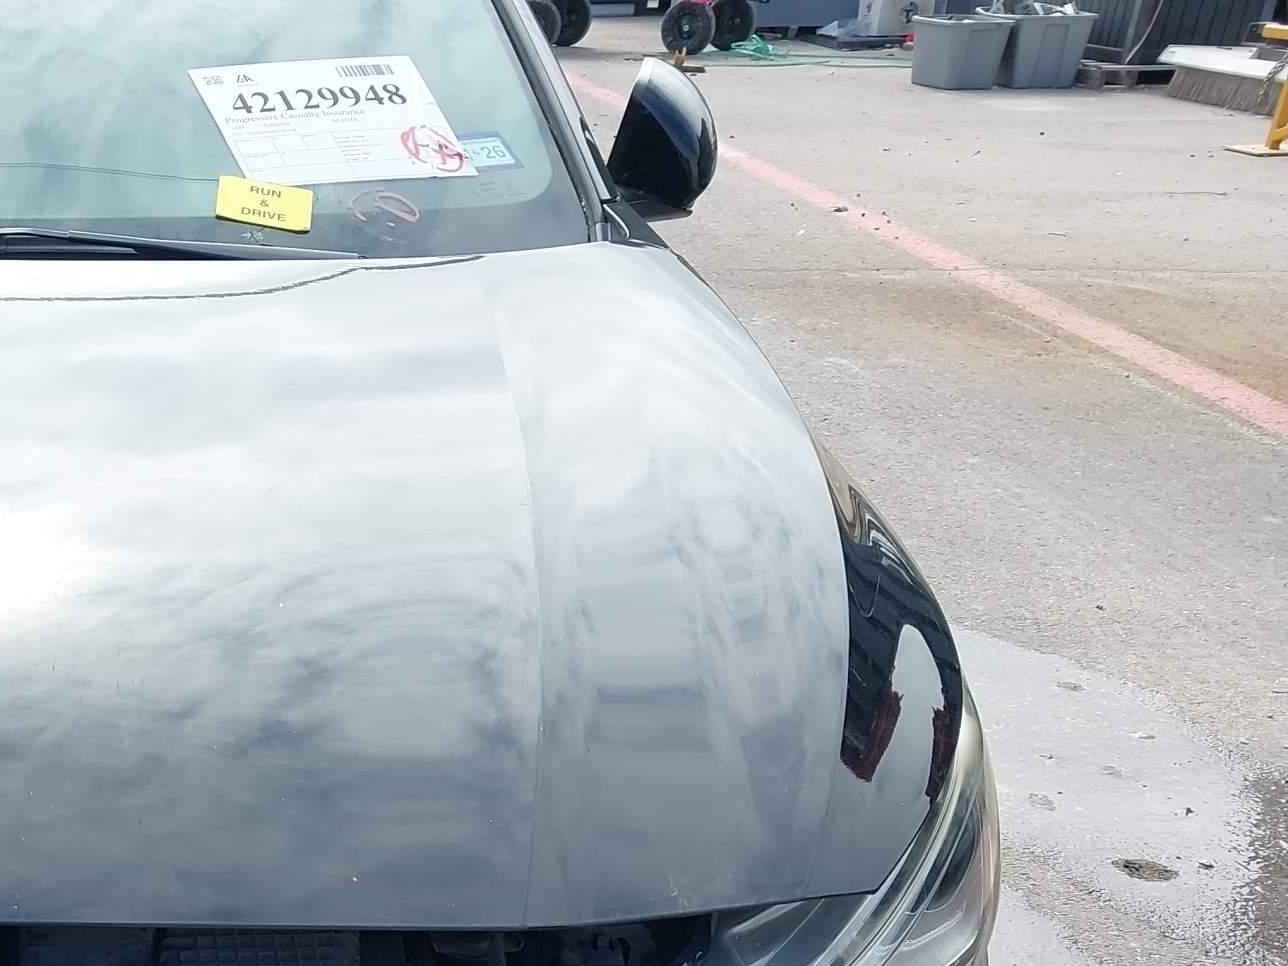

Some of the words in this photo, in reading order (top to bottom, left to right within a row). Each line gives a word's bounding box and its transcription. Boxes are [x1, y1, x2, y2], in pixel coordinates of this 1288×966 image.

[232, 83, 407, 113] 42129948
[250, 185, 281, 198] RUN
[259, 199, 269, 207] &
[241, 207, 287, 221] DRIVE
